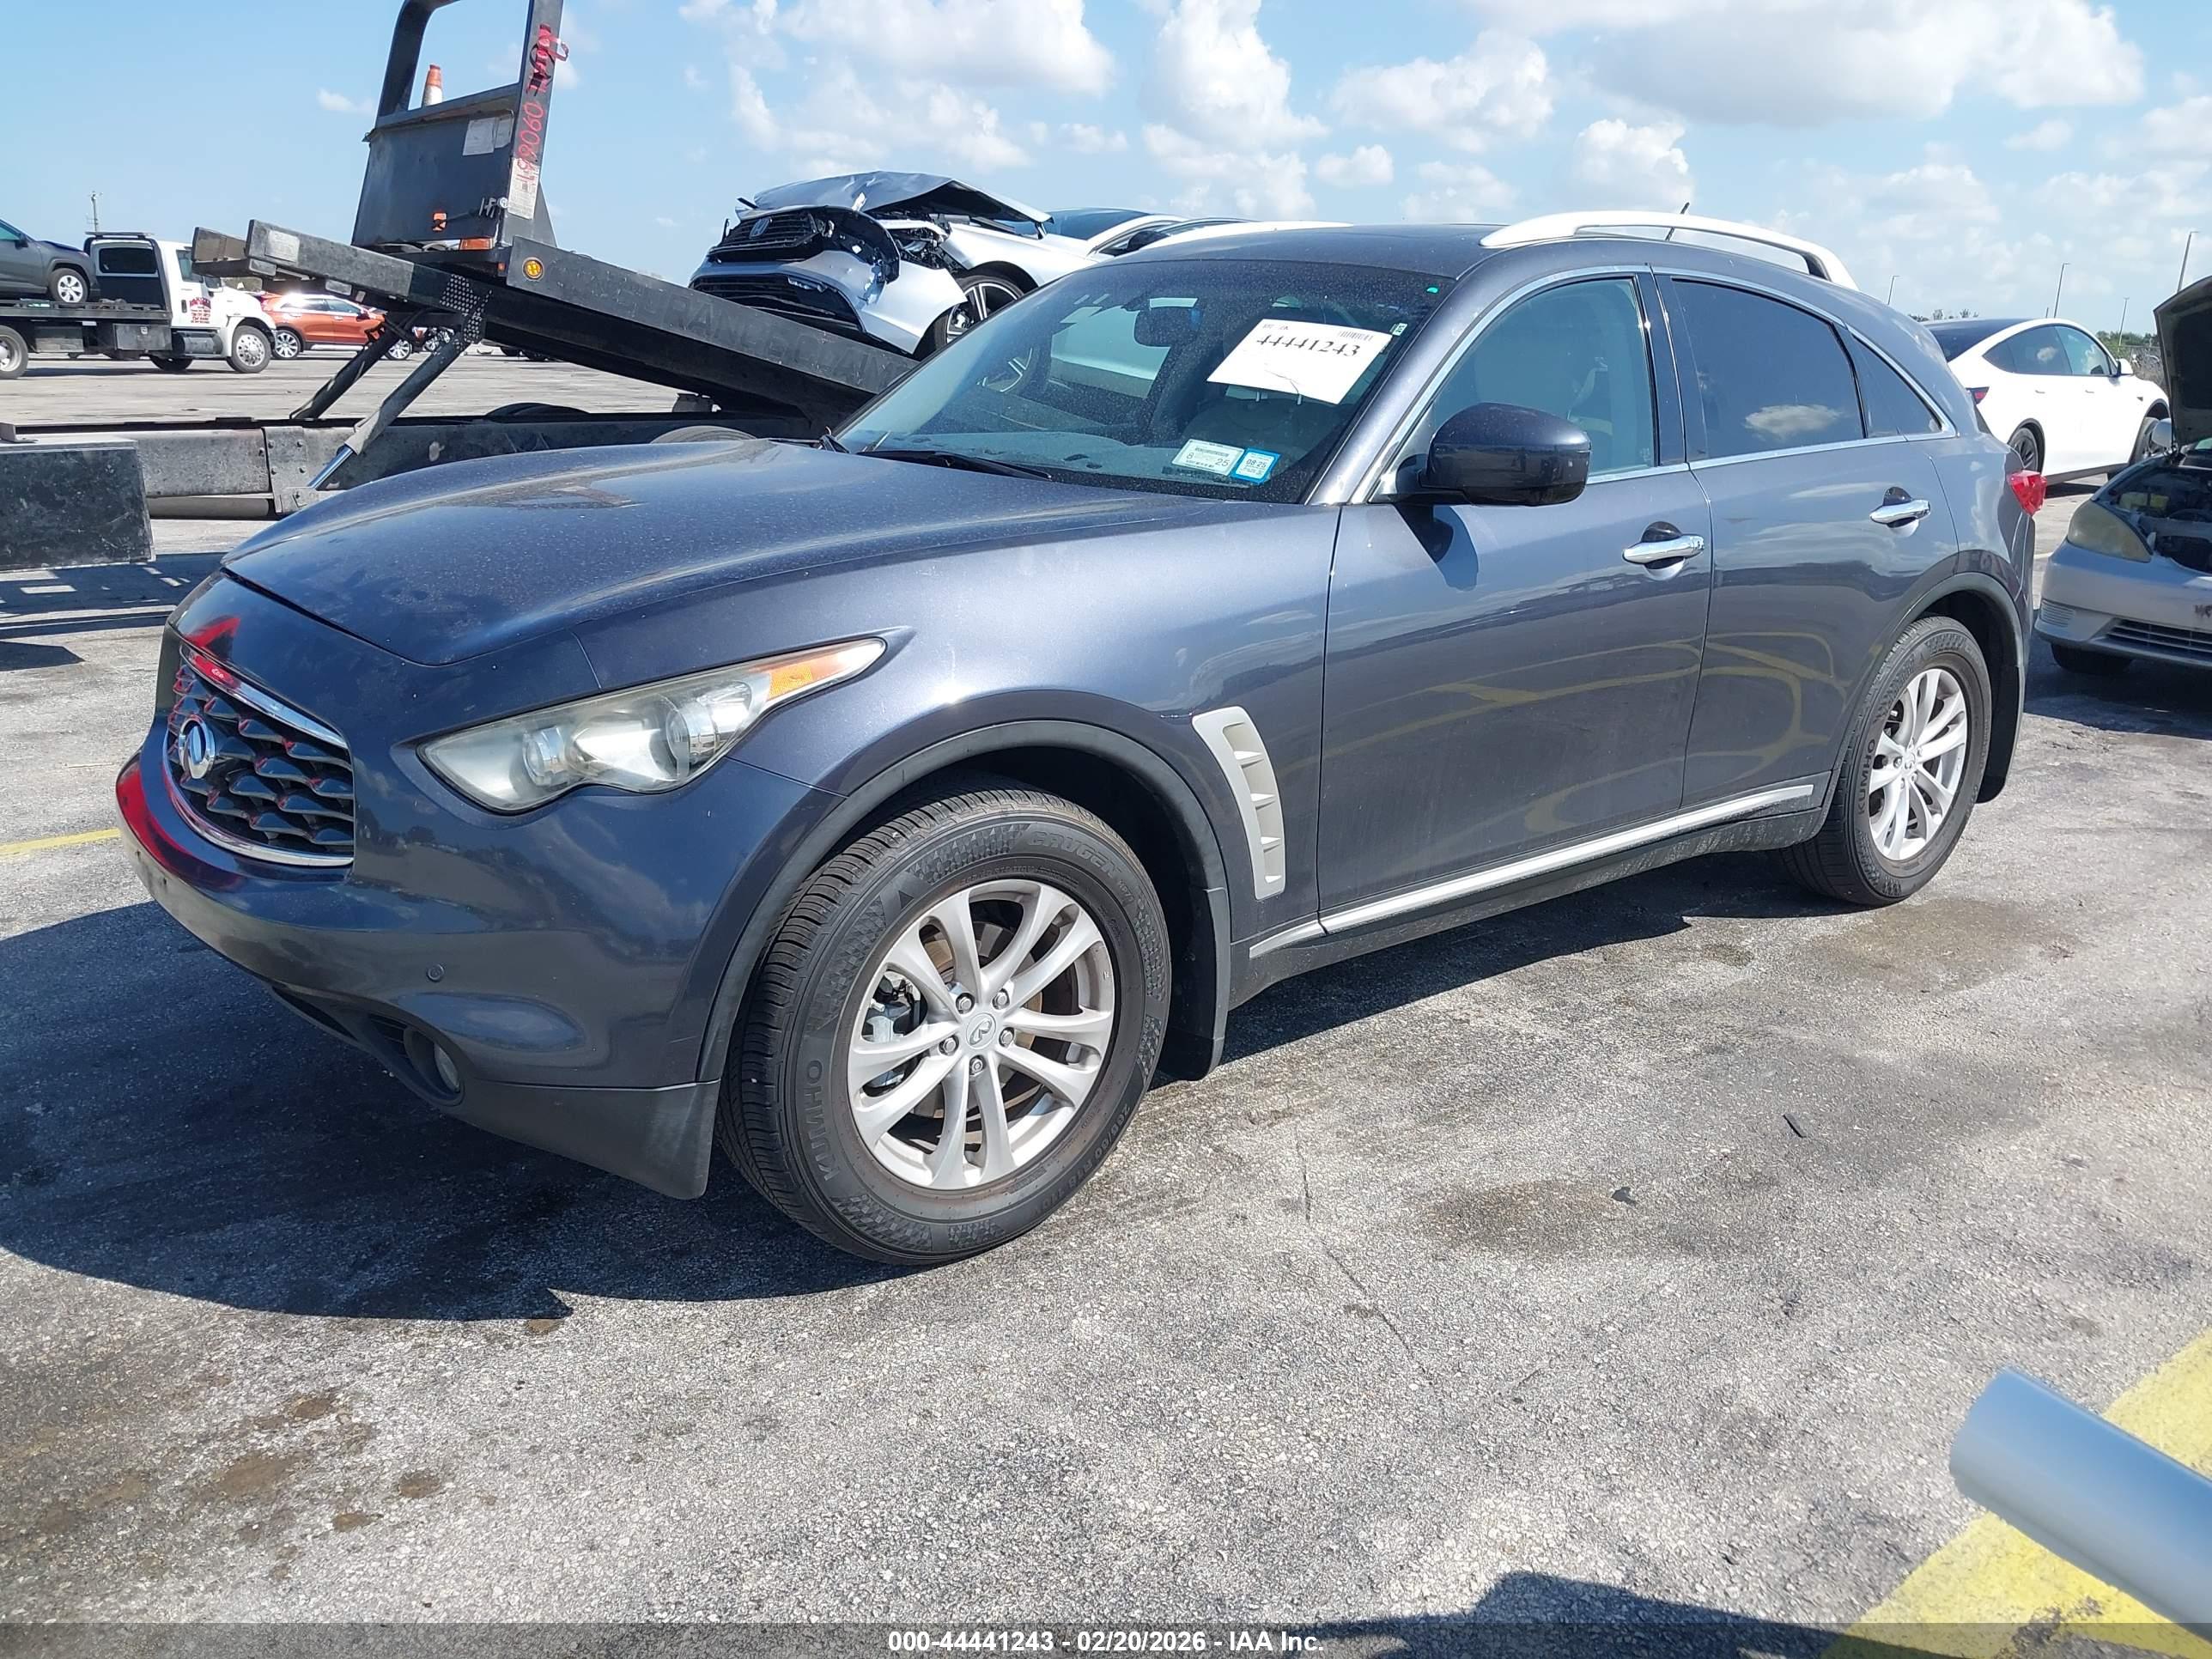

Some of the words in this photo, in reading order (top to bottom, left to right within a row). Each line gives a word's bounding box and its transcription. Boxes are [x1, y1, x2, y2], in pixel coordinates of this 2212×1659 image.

[1256, 334, 1361, 357] 44441243
[1215, 458, 1231, 467] 25
[1858, 739, 1875, 815] KUMHO
[803, 1060, 841, 1182] KUMHO
